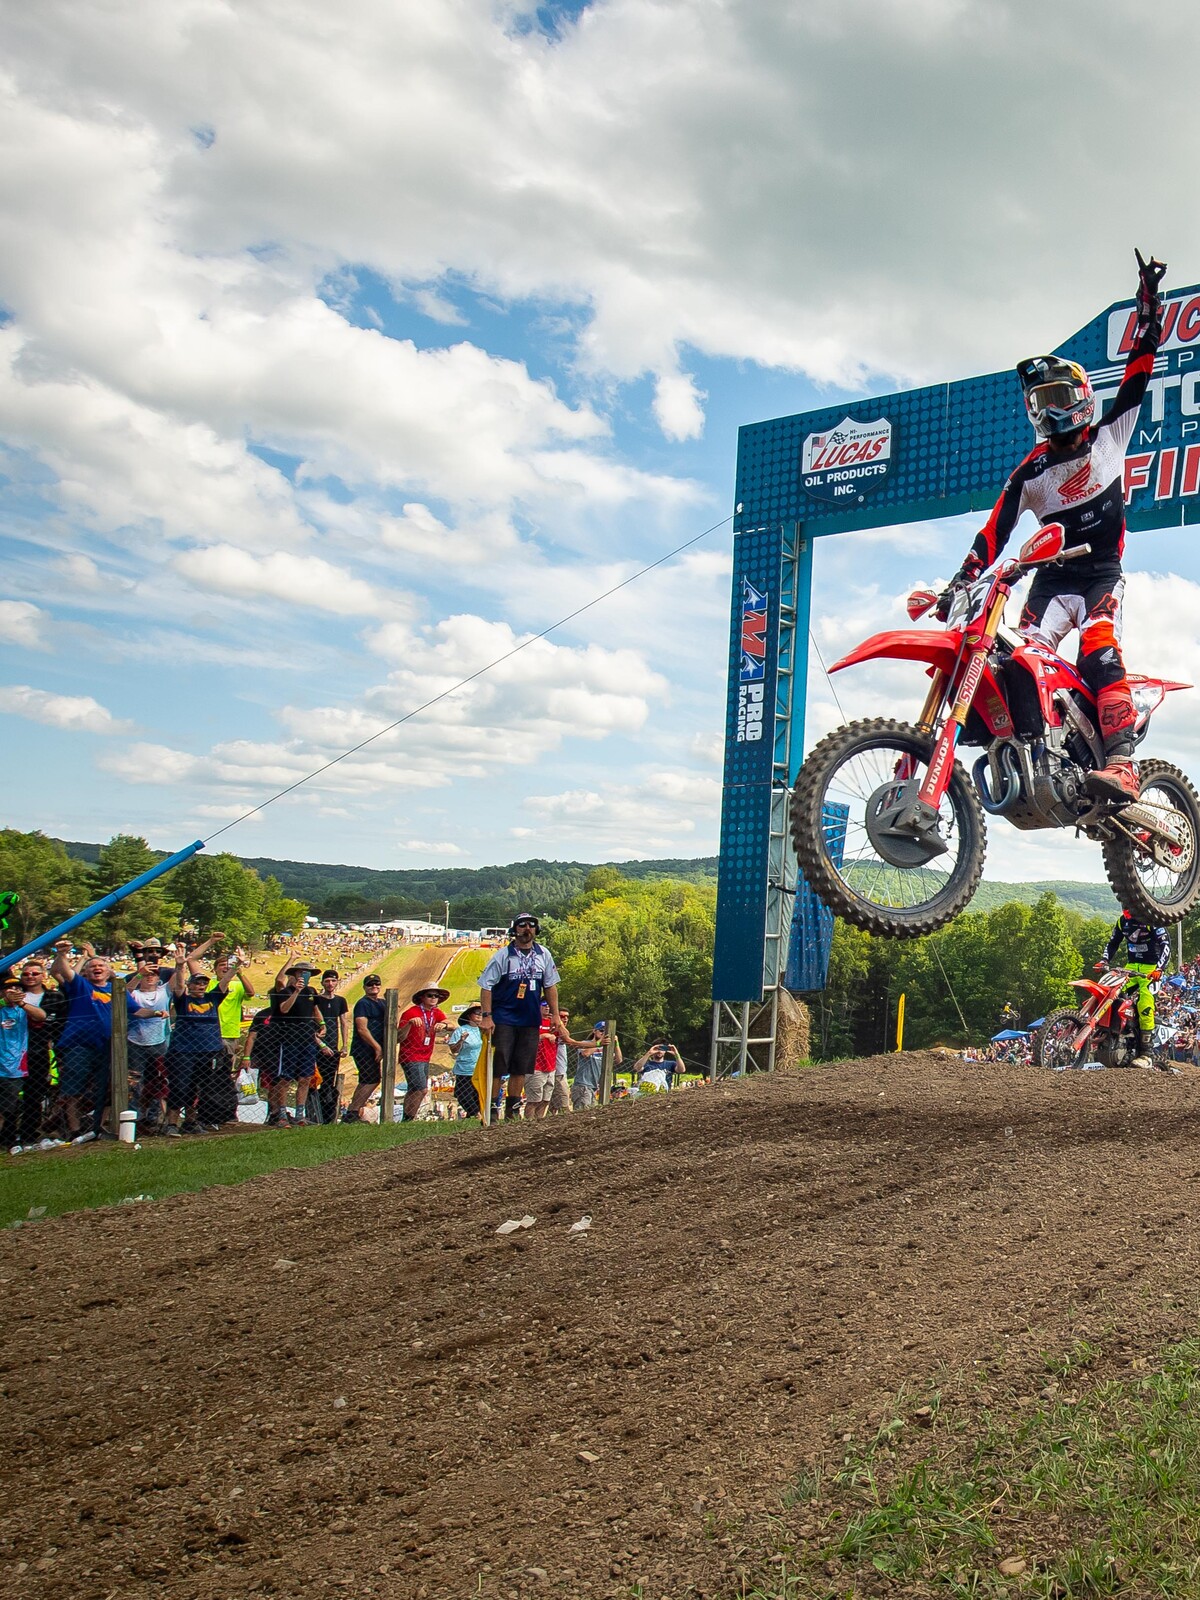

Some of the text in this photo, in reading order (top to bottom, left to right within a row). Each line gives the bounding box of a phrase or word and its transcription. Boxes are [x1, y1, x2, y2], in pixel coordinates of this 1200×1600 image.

[849, 428, 890, 440] PERFORMANCE
[810, 436, 888, 470] LUCAS
[804, 464, 887, 487] OIL PRODUCTS
[834, 484, 856, 496] INC.
[1060, 483, 1102, 506] HONDA
[739, 575, 769, 682] AMA
[960, 656, 984, 703] SHOWA
[736, 685, 748, 743] RACING
[745, 682, 765, 742] PRO
[926, 737, 950, 796] DUNLOP
[1157, 944, 1171, 969] UFO
